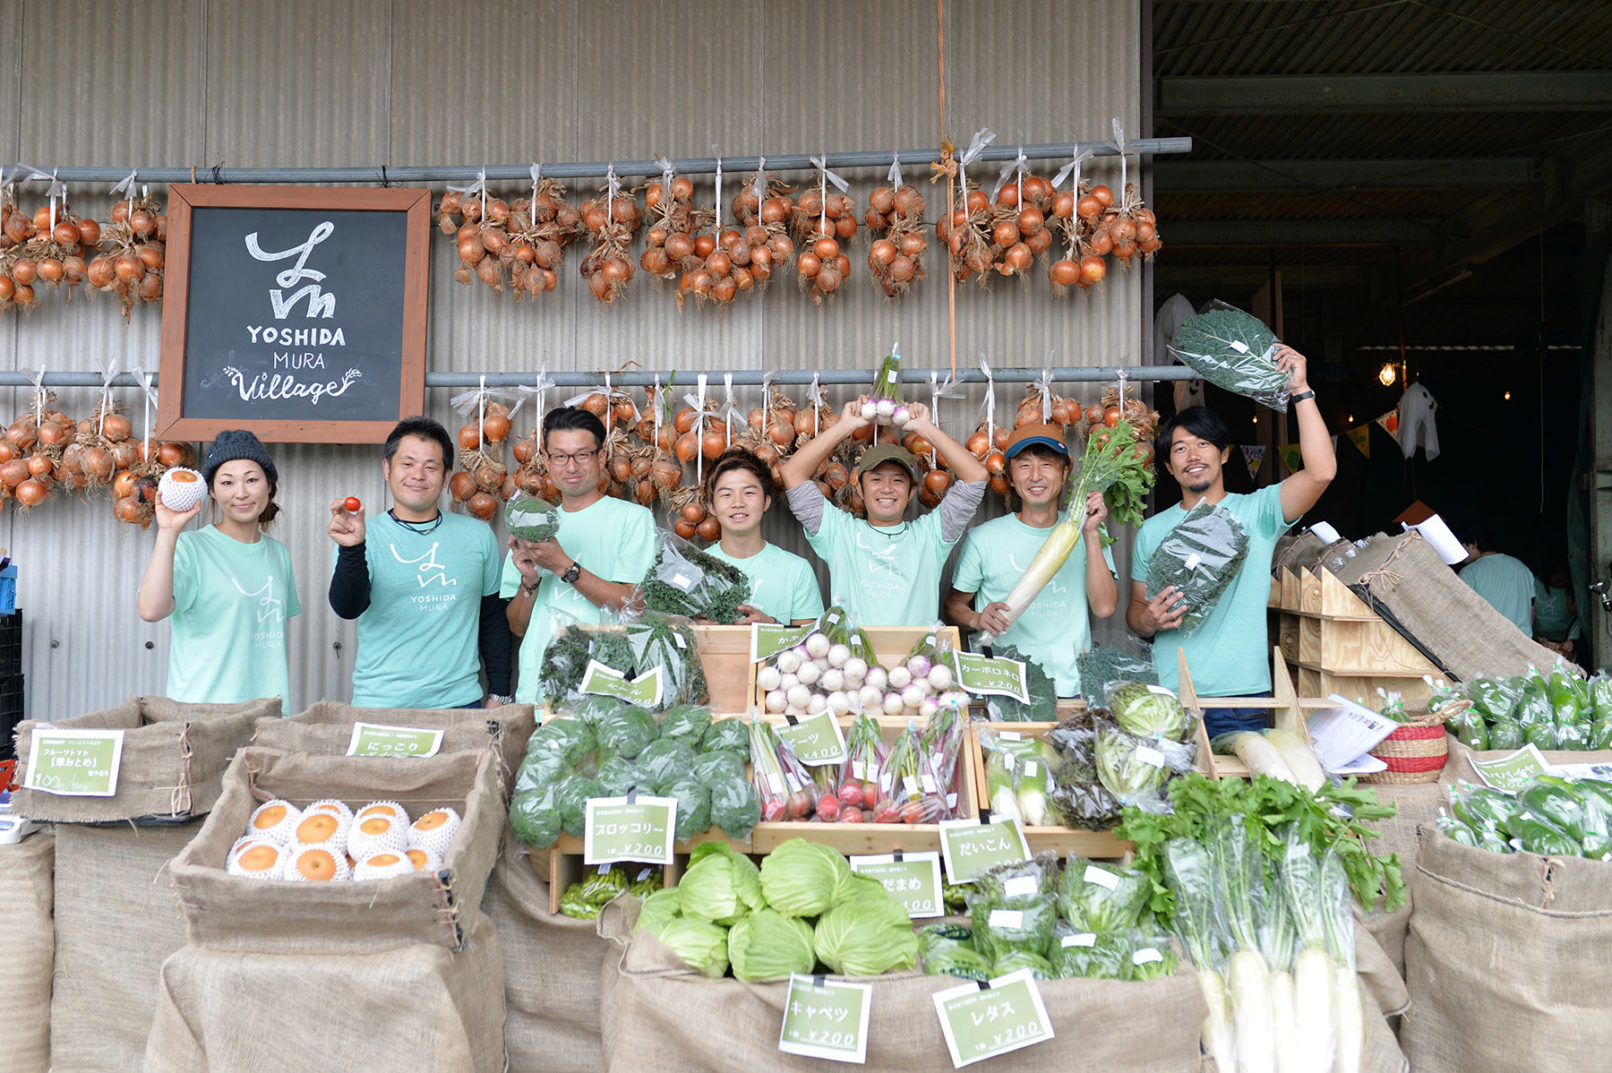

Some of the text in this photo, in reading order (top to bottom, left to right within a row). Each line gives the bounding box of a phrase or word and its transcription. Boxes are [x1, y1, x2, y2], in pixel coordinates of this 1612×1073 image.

[247, 326, 346, 346] YOSHIDA
[273, 352, 325, 370] MURA
[231, 371, 350, 405] Village
[411, 594, 456, 603] YOSHIDA
[1030, 601, 1066, 609] OSHIDA
[420, 602, 448, 612] MURA
[251, 632, 284, 640] OSHID
[988, 681, 1021, 694] ¥200
[43, 748, 89, 756] フルーツトマト
[367, 741, 419, 752] にっこり
[803, 745, 838, 758] ¥400
[624, 843, 663, 856] ¥200
[959, 837, 1012, 857] だいこん
[882, 877, 922, 892] だまめ
[790, 1000, 849, 1024] キャベツ
[970, 1001, 1017, 1027] レタス
[809, 1028, 855, 1047] ¥200
[993, 1020, 1039, 1046] ¥200
